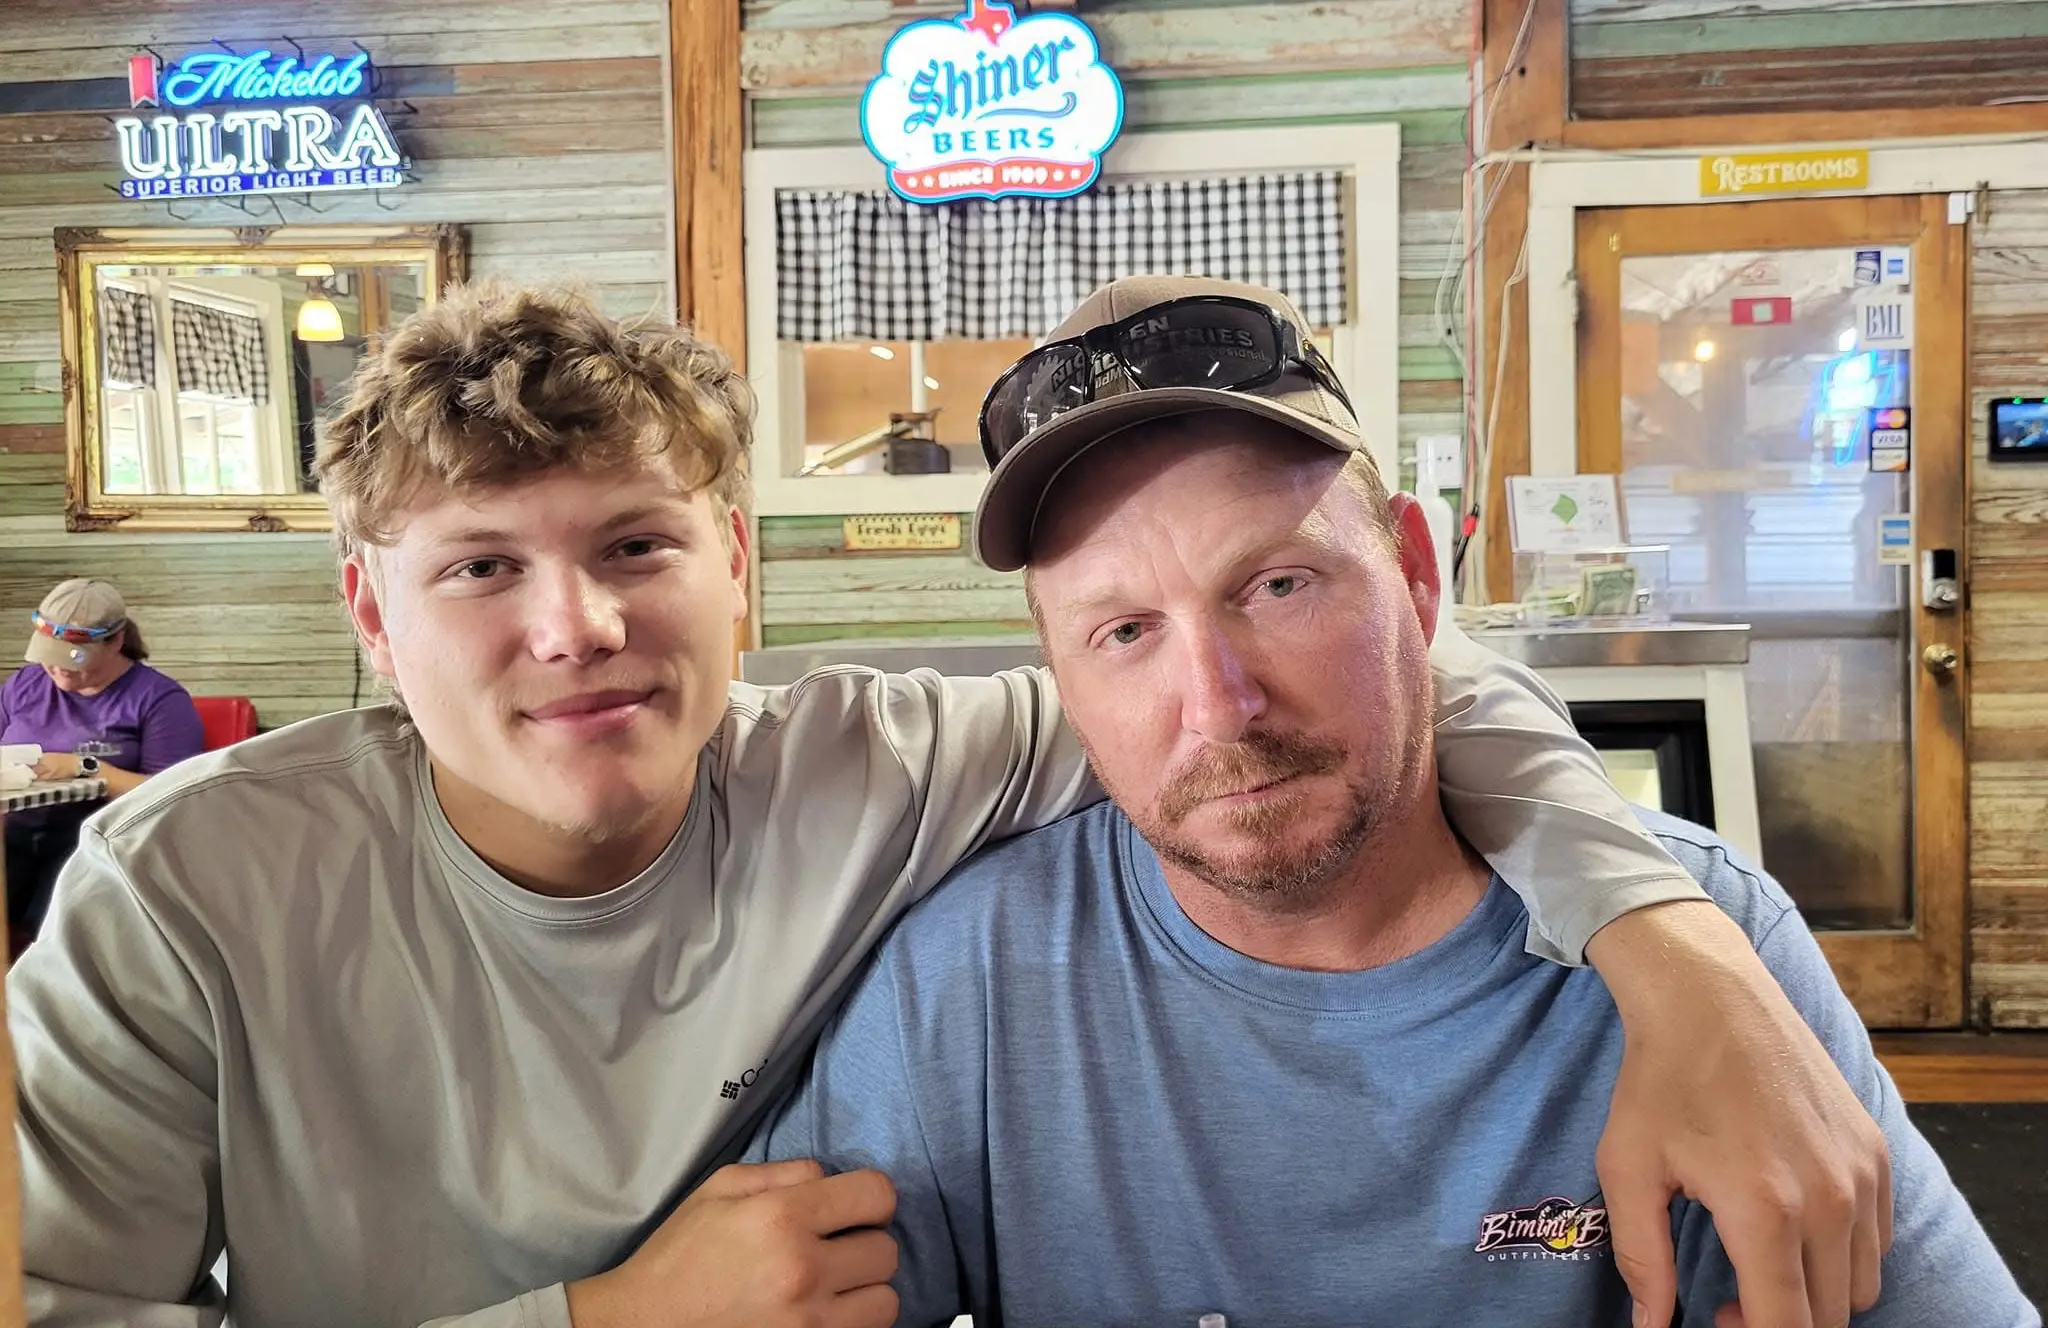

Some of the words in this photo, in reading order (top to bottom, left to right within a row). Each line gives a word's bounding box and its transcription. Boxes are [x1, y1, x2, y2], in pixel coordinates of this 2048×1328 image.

[164, 50, 368, 105] Michelob
[904, 36, 1075, 133] Shiner
[115, 104, 400, 180] ULTRA
[932, 127, 1055, 153] BEERS
[121, 175, 243, 198] SUPERIOR
[253, 171, 322, 190] LIGHT
[332, 167, 395, 185] BEER
[1866, 304, 1902, 337] BMI
[1475, 1211, 1567, 1252] Bimini
[1487, 1252, 1591, 1262] OUTFITTERS
